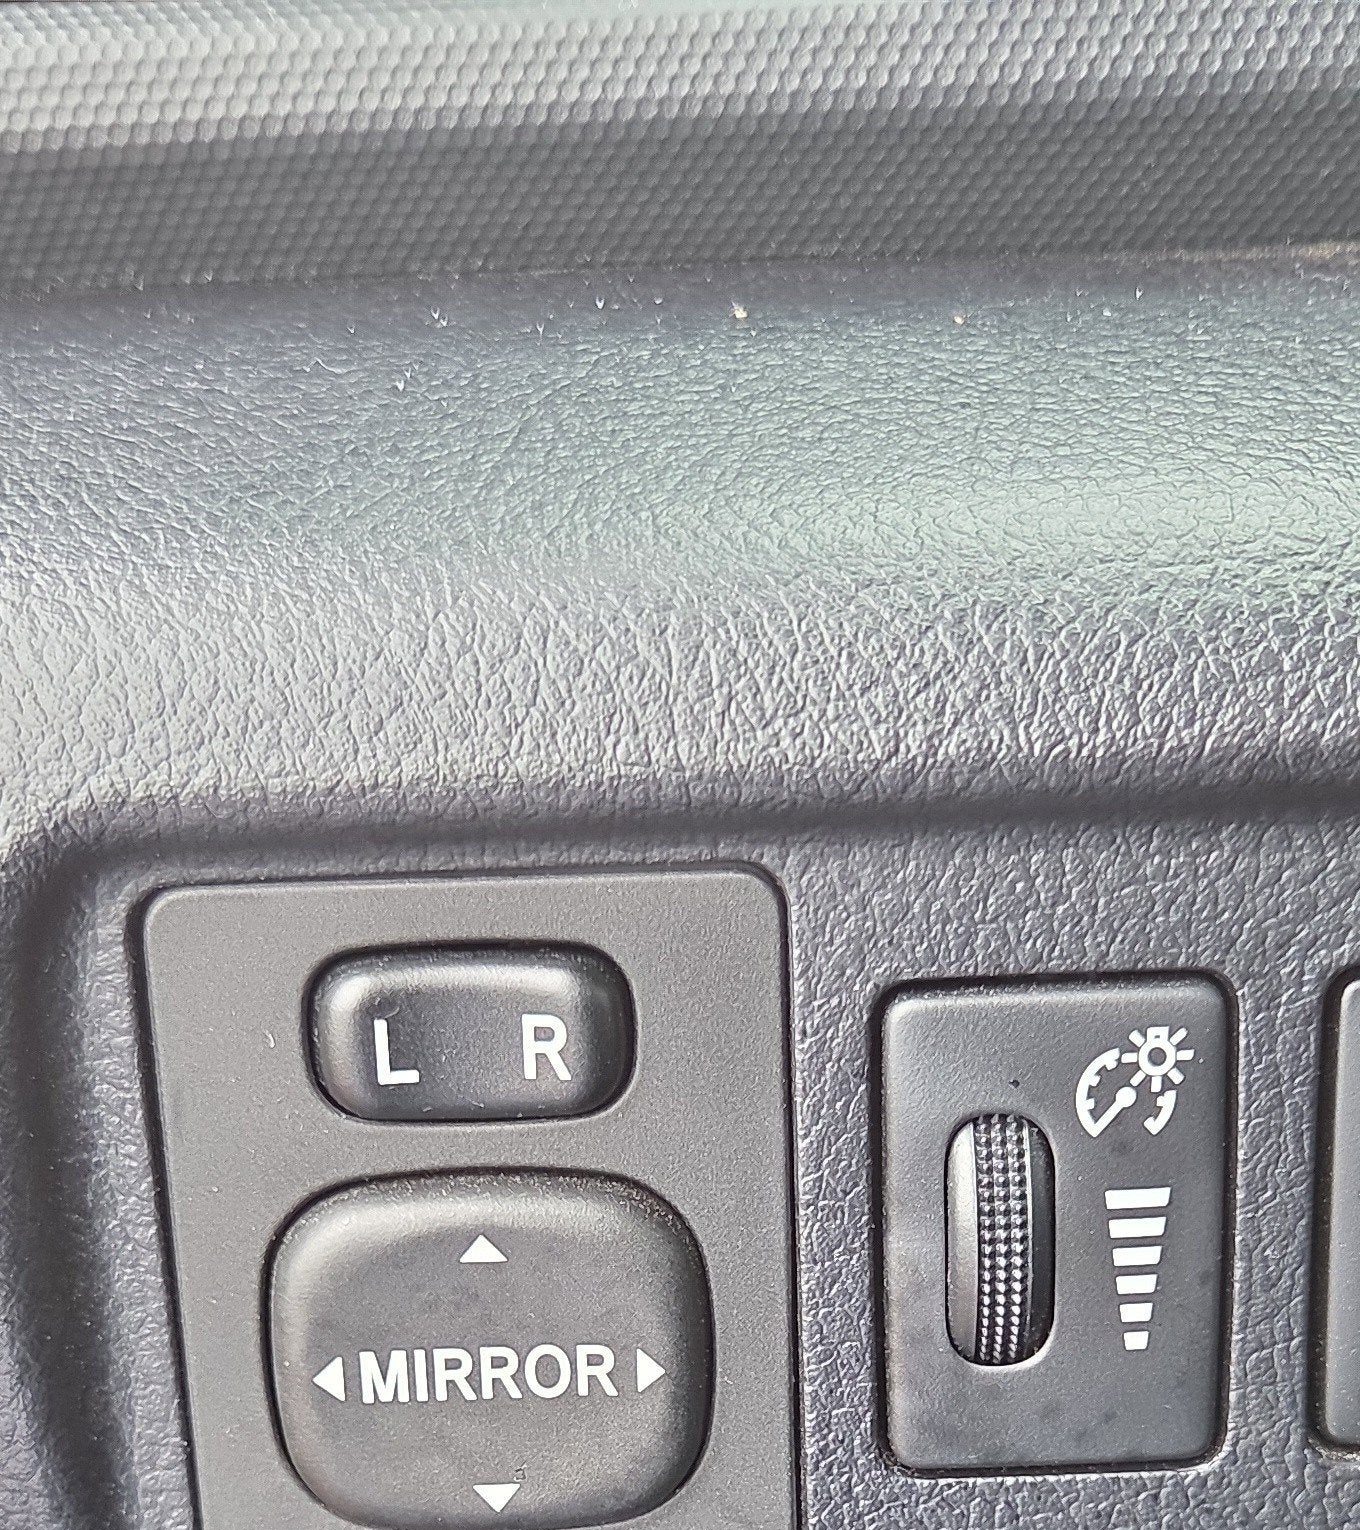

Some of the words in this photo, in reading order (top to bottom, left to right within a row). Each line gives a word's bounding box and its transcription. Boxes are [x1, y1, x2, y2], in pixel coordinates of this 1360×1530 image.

[373, 1018, 420, 1086] L
[520, 1013, 573, 1082] R
[358, 1344, 619, 1405] MIRROR
